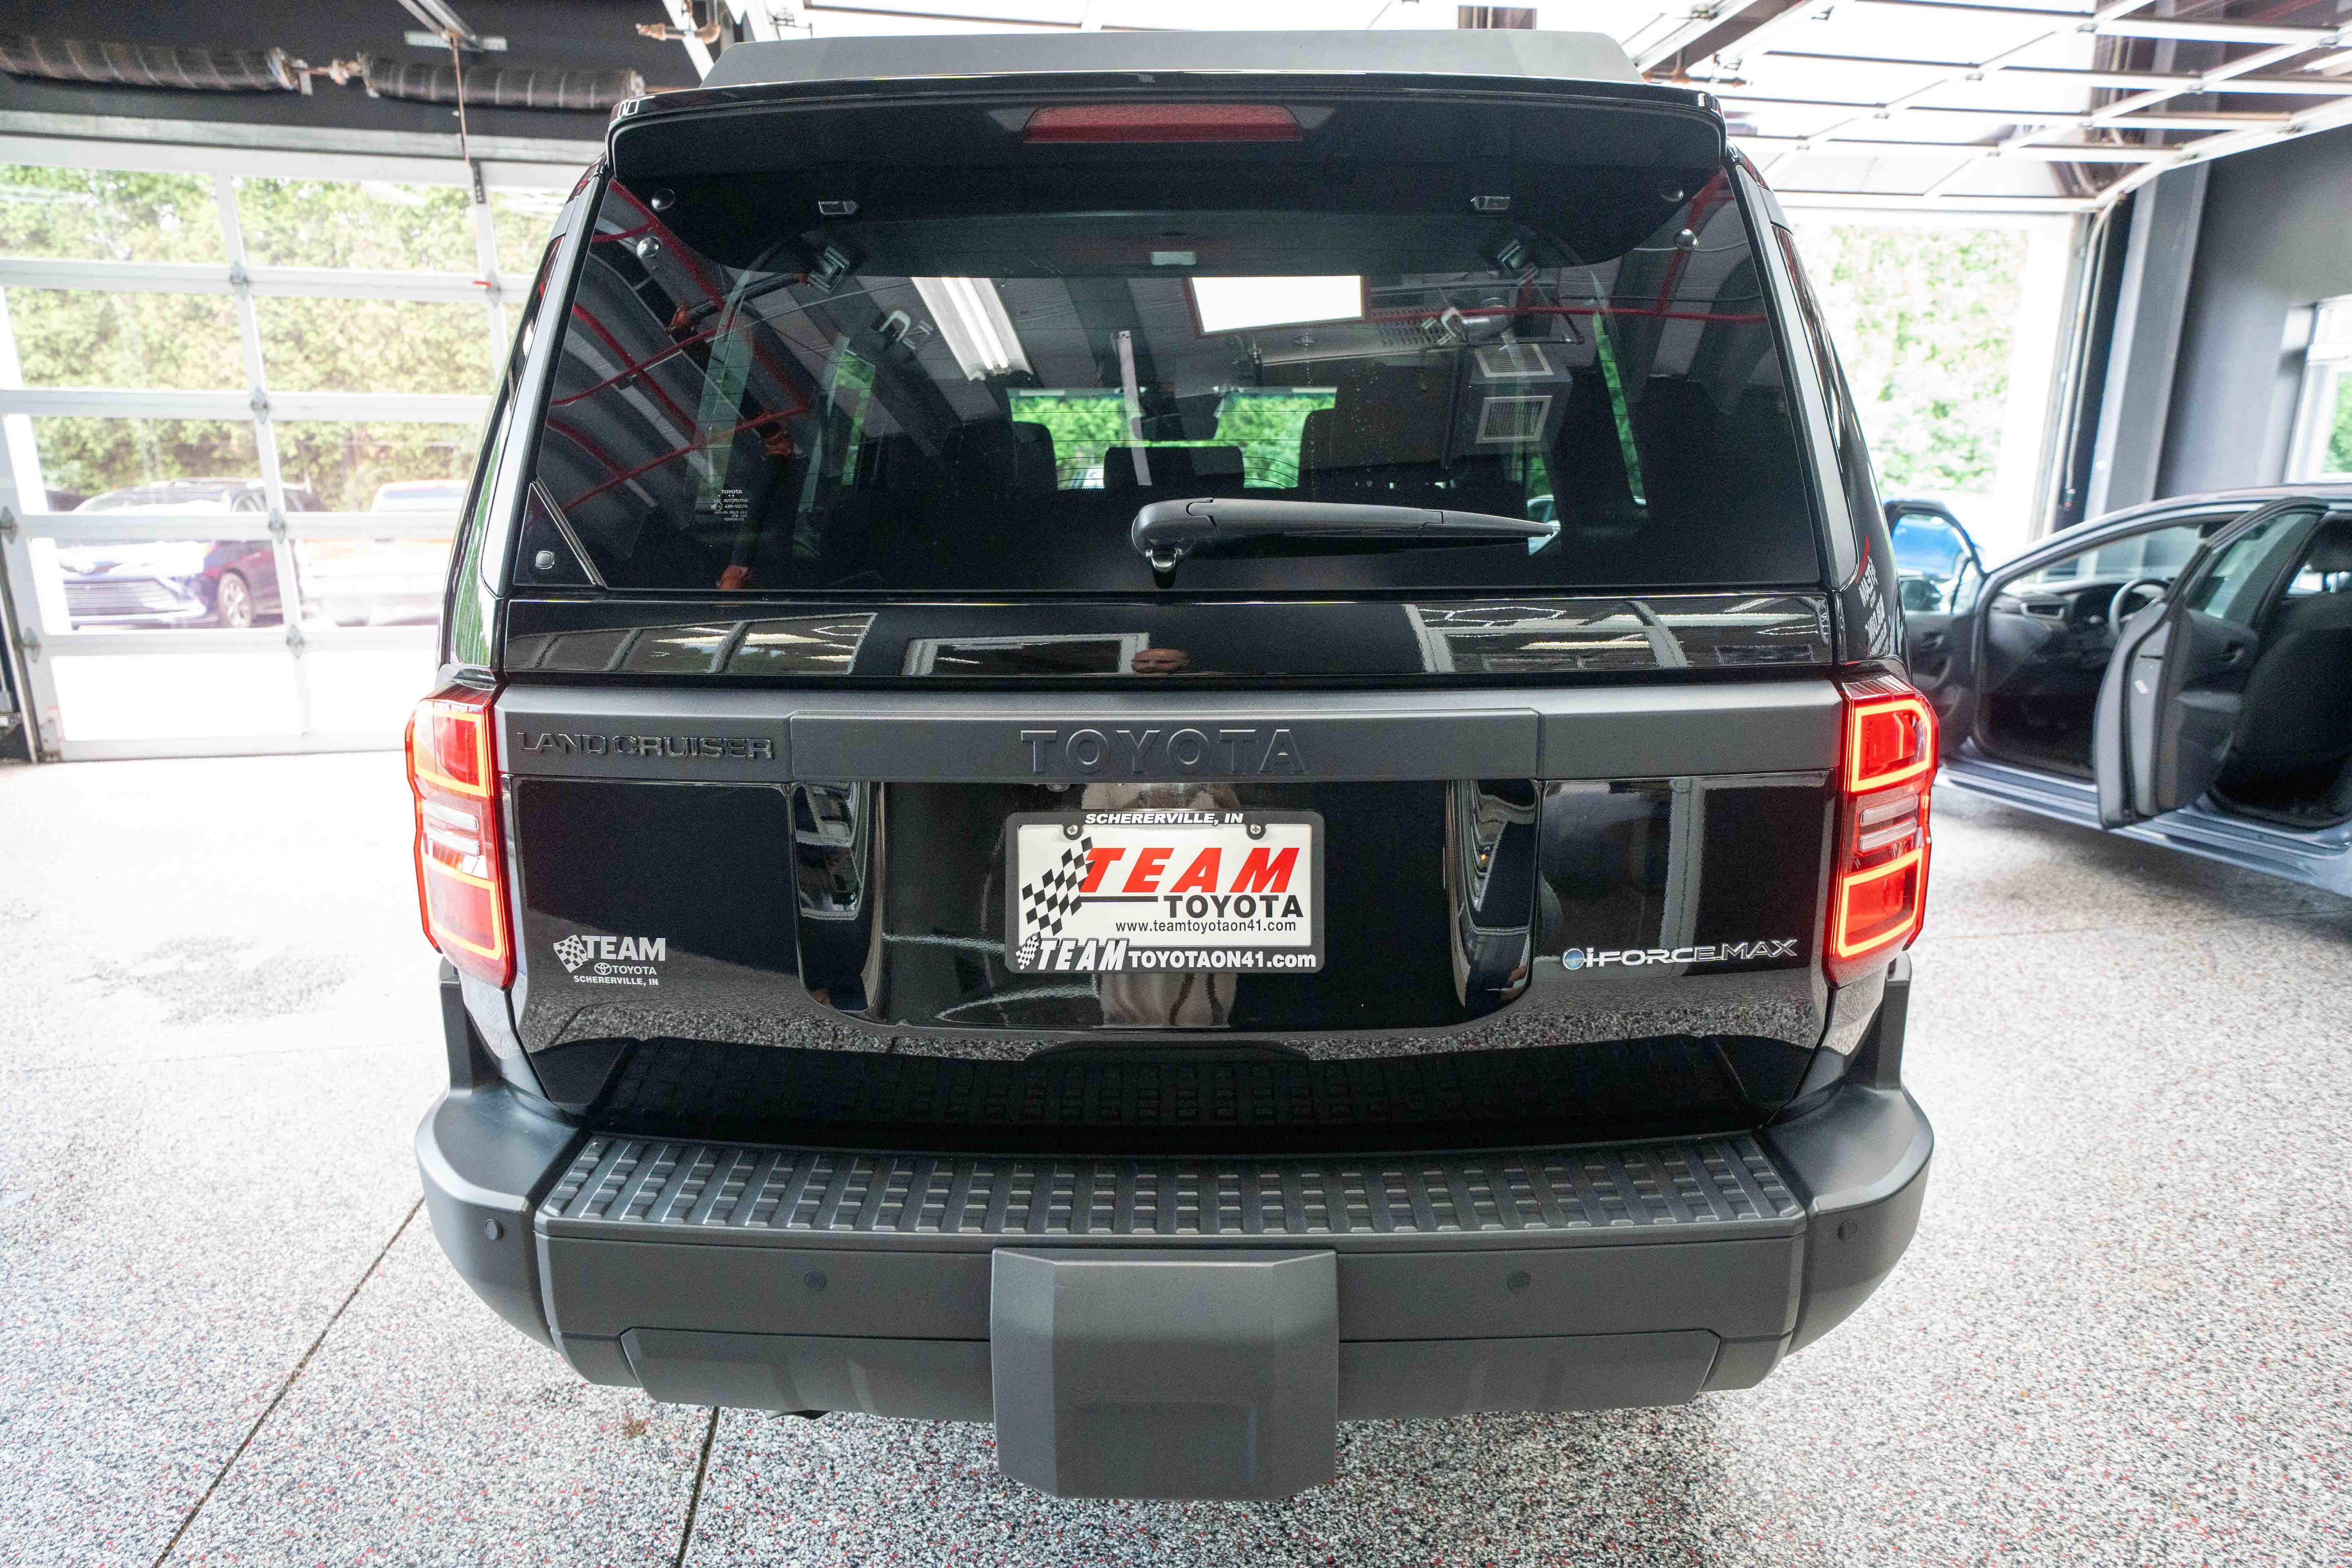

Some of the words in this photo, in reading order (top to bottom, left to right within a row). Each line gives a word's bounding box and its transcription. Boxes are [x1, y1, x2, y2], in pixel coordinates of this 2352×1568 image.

[517, 731, 606, 755] LAND
[612, 735, 773, 759] CRUISER
[1019, 728, 1310, 773] TOYOTA
[1085, 813, 1220, 826] SCHERERVILLE,
[1225, 813, 1243, 823] IN
[1079, 847, 1300, 893] TEAM
[1163, 895, 1303, 918] TOYOTA
[1115, 919, 1296, 934] www.teamtoyotaon41.com
[581, 935, 666, 961] TEAM
[1721, 938, 1798, 961] MAX
[573, 975, 646, 986] SCHERERVILLE,
[611, 965, 657, 975] TOYOTA
